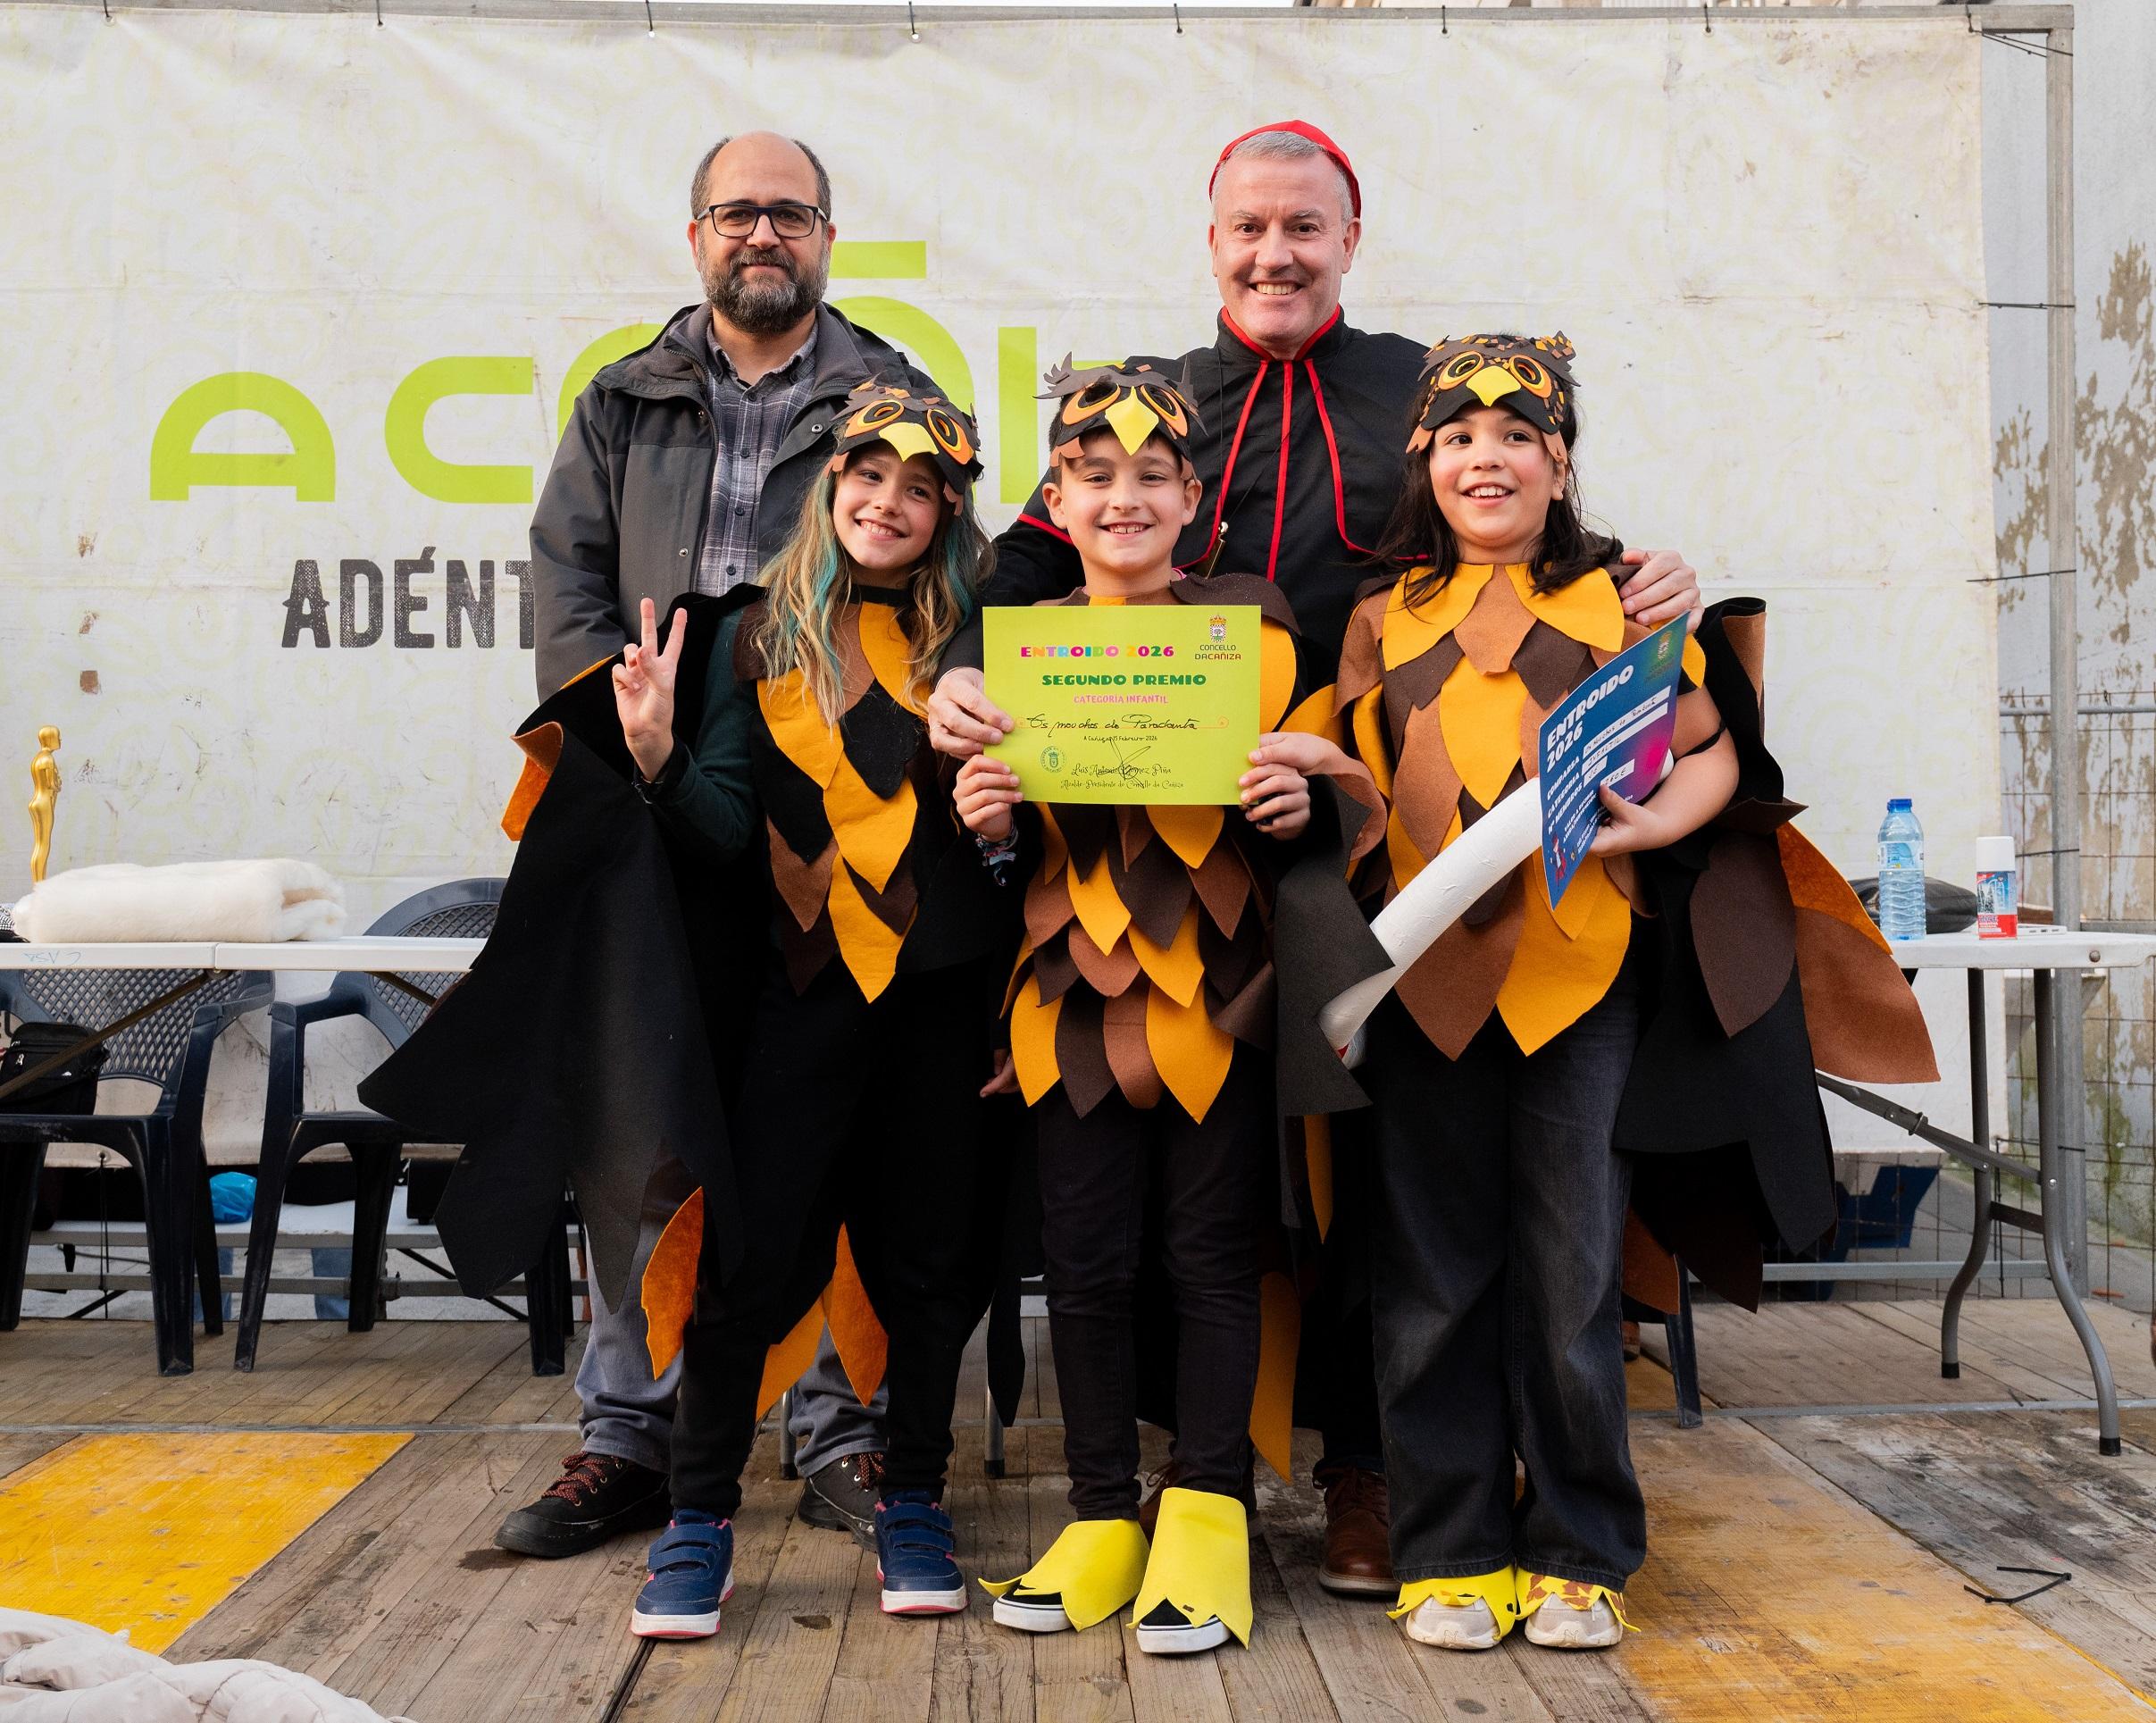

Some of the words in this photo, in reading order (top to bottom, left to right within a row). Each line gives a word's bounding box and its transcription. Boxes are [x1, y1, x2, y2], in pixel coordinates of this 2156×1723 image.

[1021, 646, 1119, 657] ENTROIDO
[1126, 646, 1174, 657] 2026
[1041, 674, 1127, 686] SEGUNDO
[1132, 674, 1207, 686] PREMIO
[1074, 695, 1124, 704] CATEGORIA
[1126, 695, 1169, 704] INFANTIL
[1547, 665, 1634, 752] ENTROIDO
[1547, 721, 1583, 774] 2026
[1072, 763, 1089, 776] Luis
